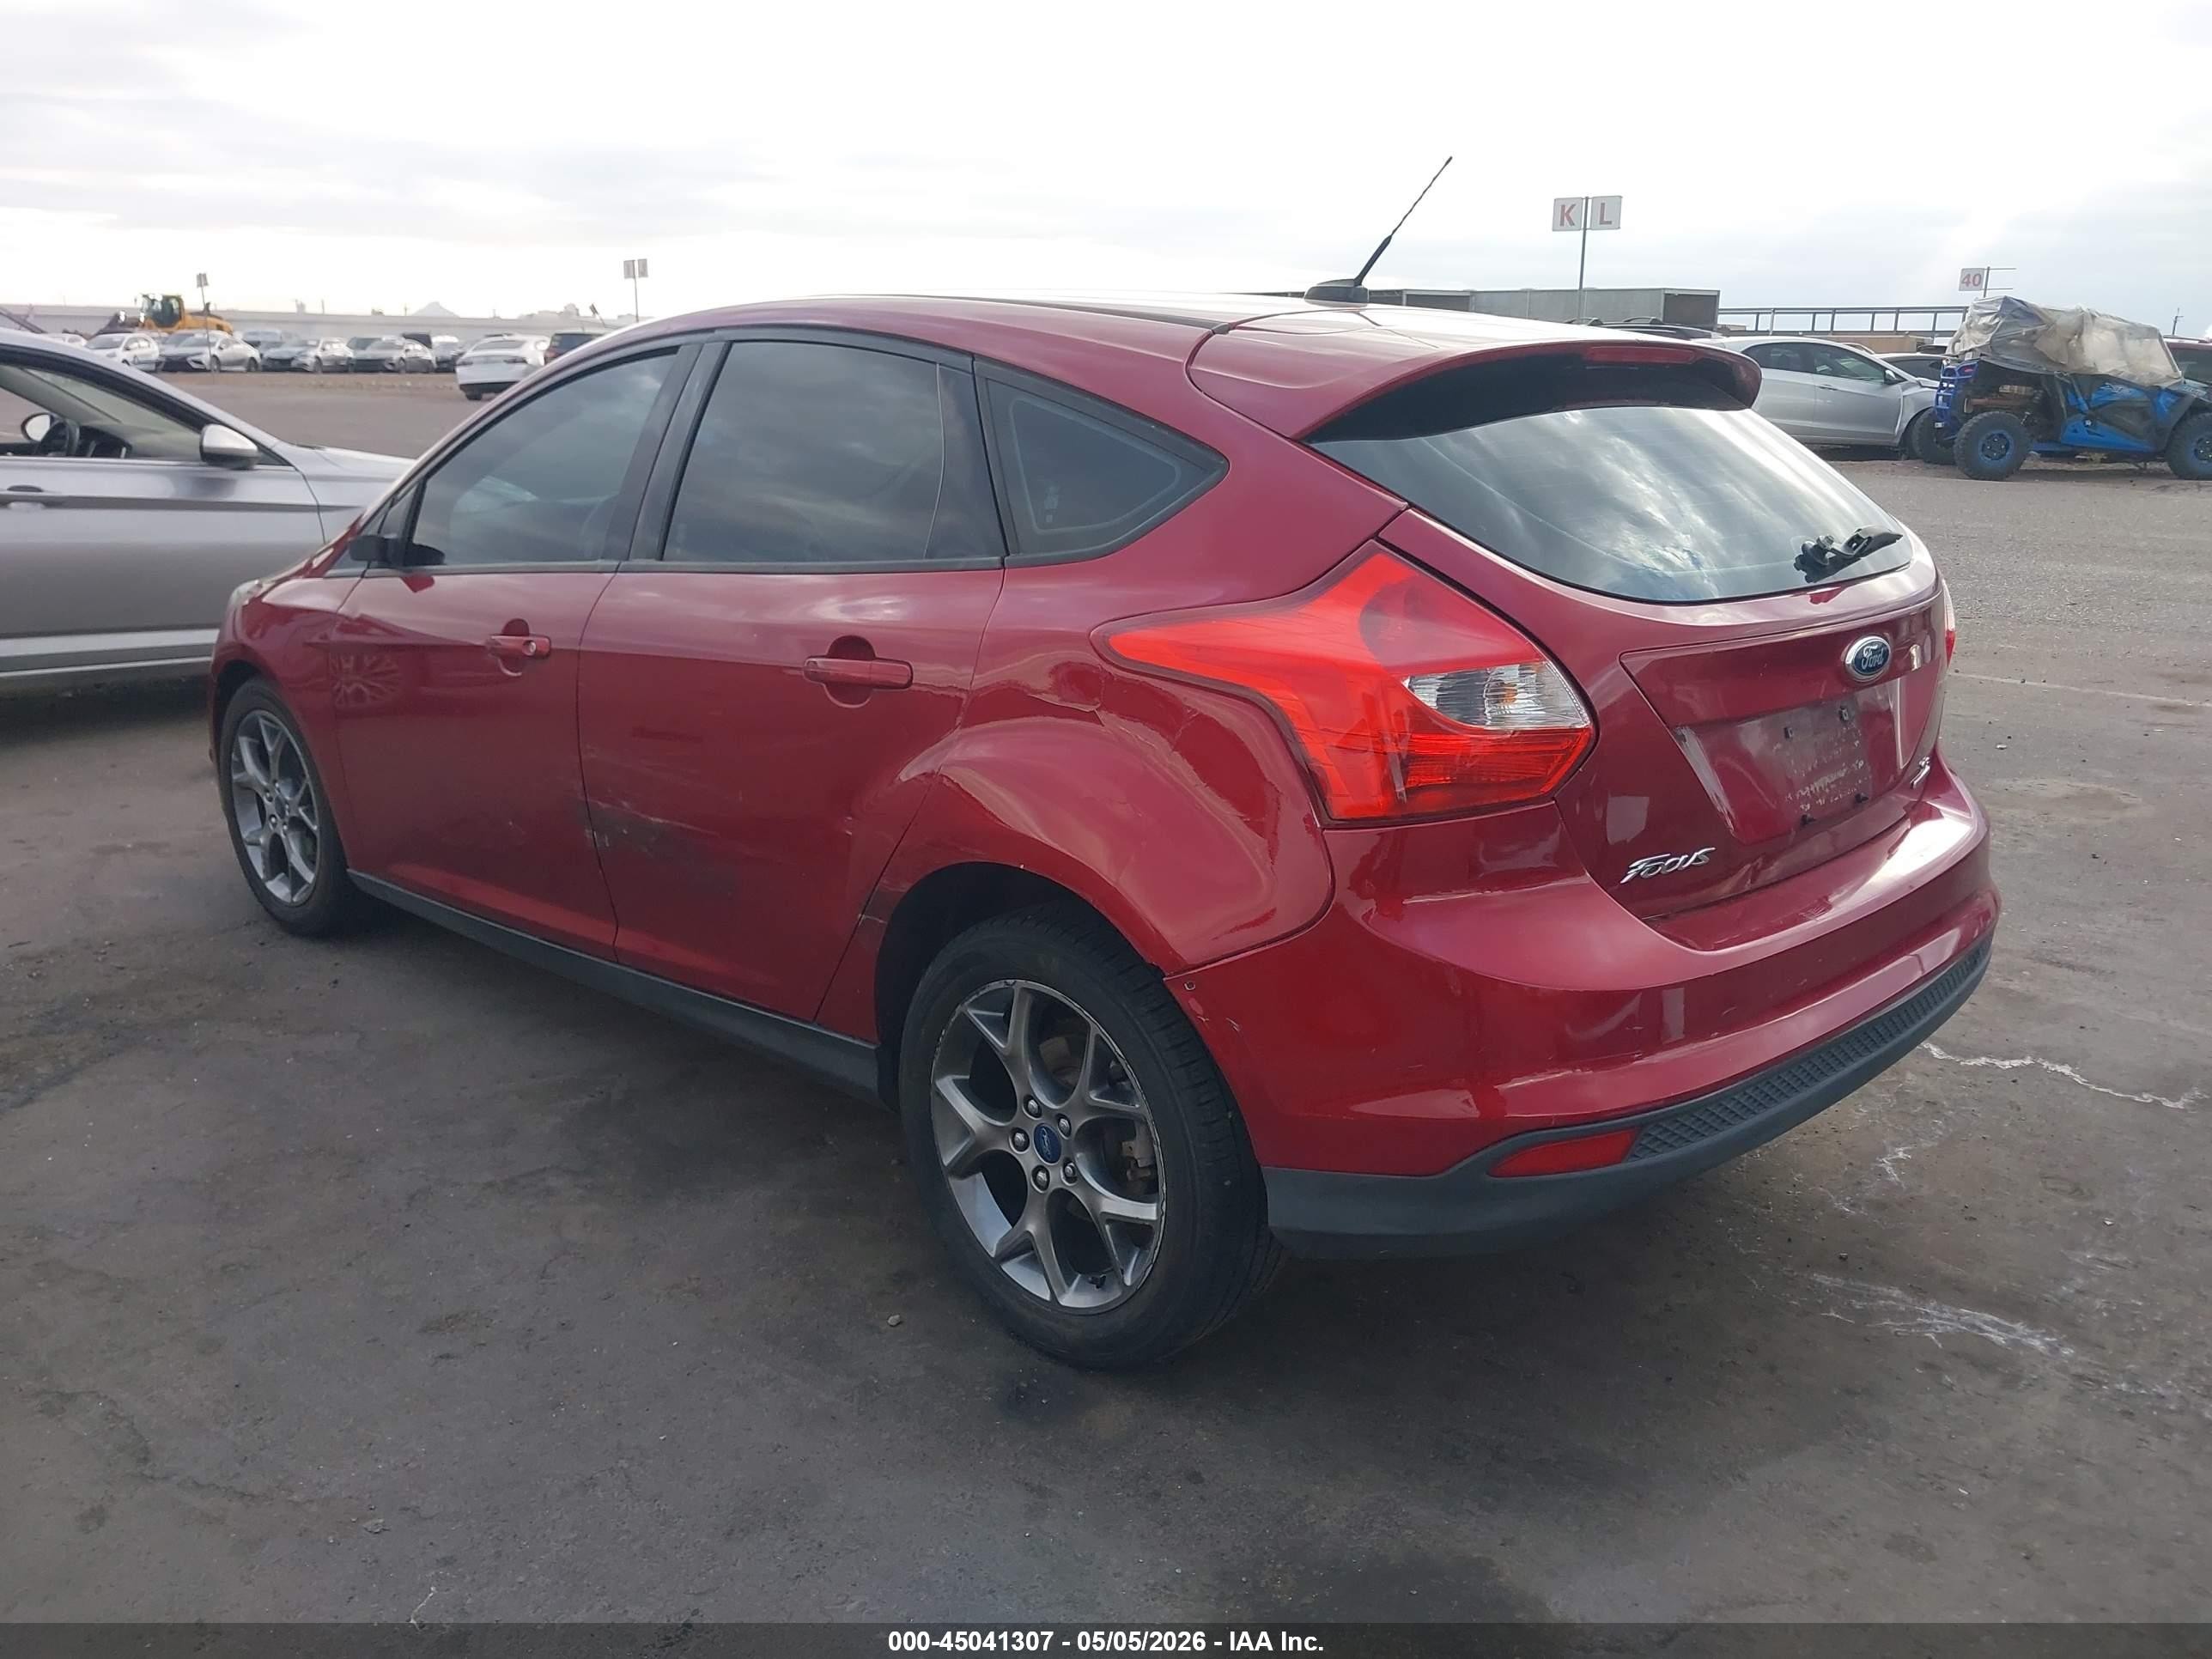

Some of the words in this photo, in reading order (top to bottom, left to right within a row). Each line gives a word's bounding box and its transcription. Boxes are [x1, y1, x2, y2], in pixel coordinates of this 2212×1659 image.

[1559, 204, 1577, 227] K
[1599, 202, 1613, 225] L
[1960, 273, 1982, 287] 40
[1861, 644, 1884, 670] Ford
